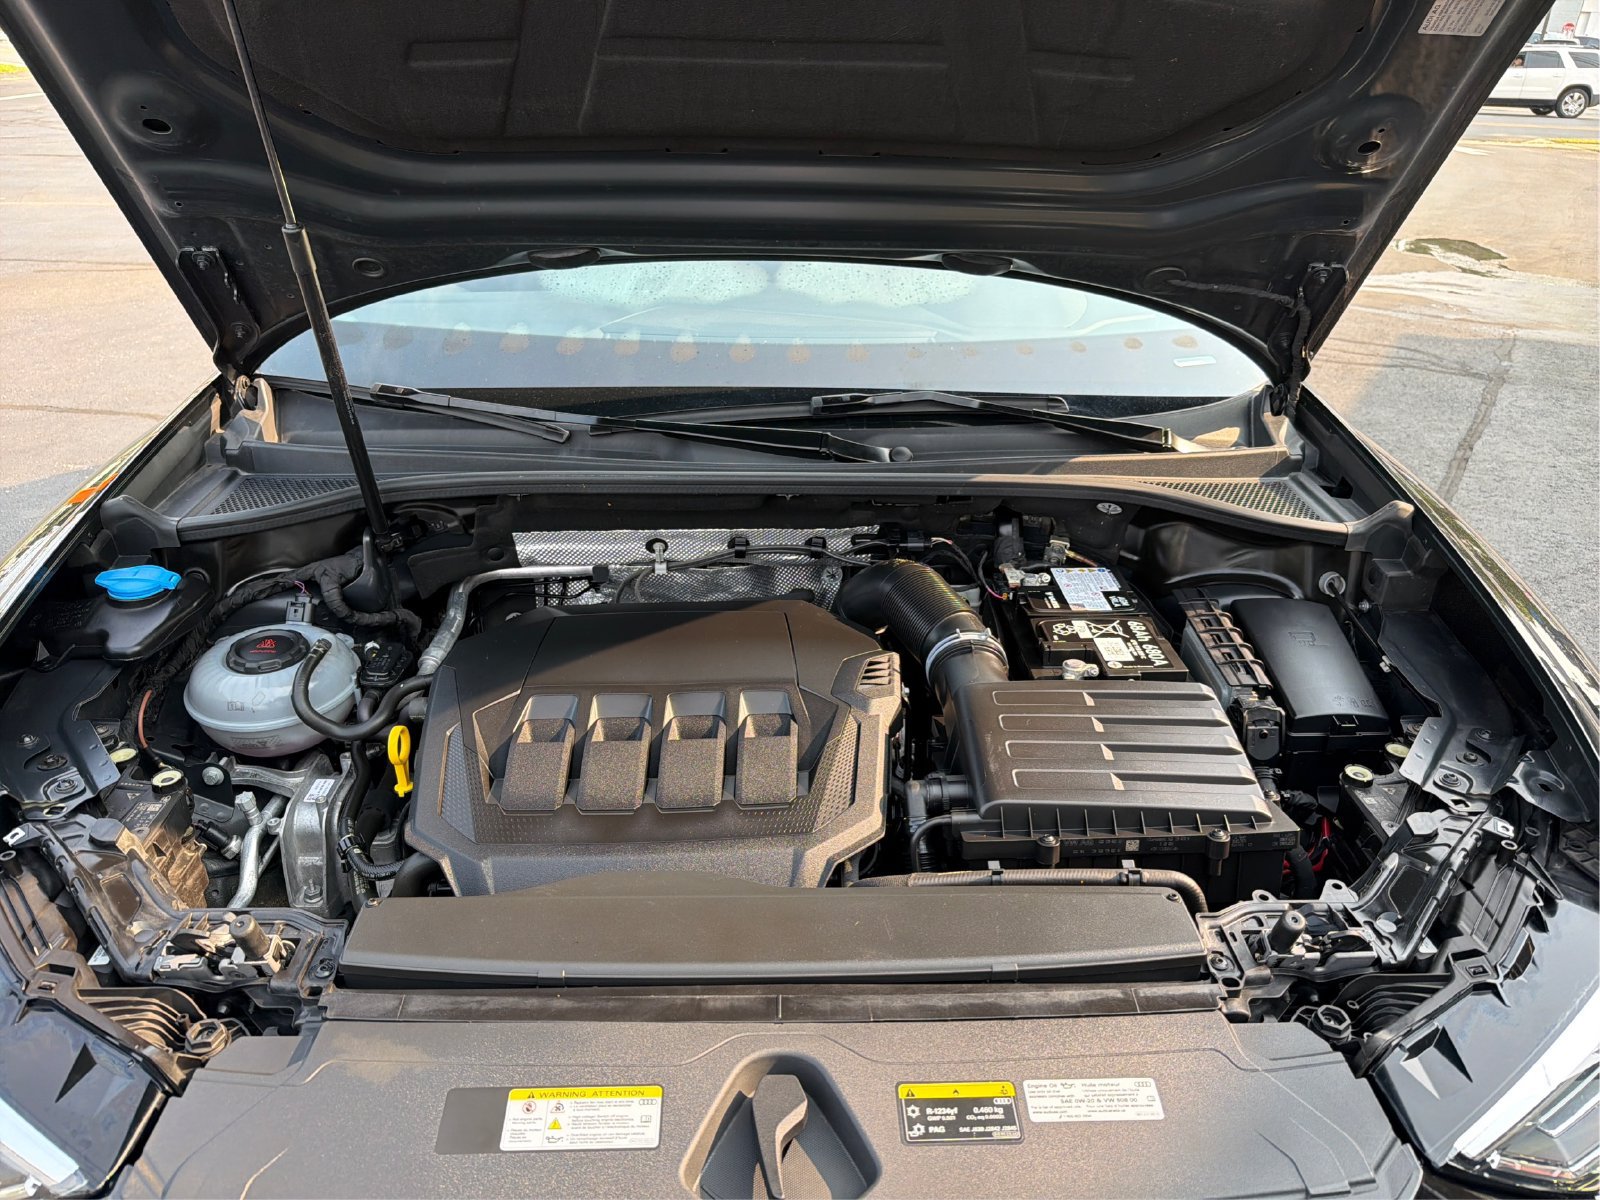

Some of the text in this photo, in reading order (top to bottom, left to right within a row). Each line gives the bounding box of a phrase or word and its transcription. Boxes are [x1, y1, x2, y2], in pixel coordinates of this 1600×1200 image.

[1422, 4, 1441, 31] AUDI AG
[1127, 620, 1152, 642] 68Ah
[1142, 643, 1169, 667] 680A
[539, 1089, 645, 1099] WARNING ATTENTION
[925, 1107, 958, 1115] R-1234yf
[994, 1106, 1004, 1114] kg
[928, 1125, 946, 1133] PAG
